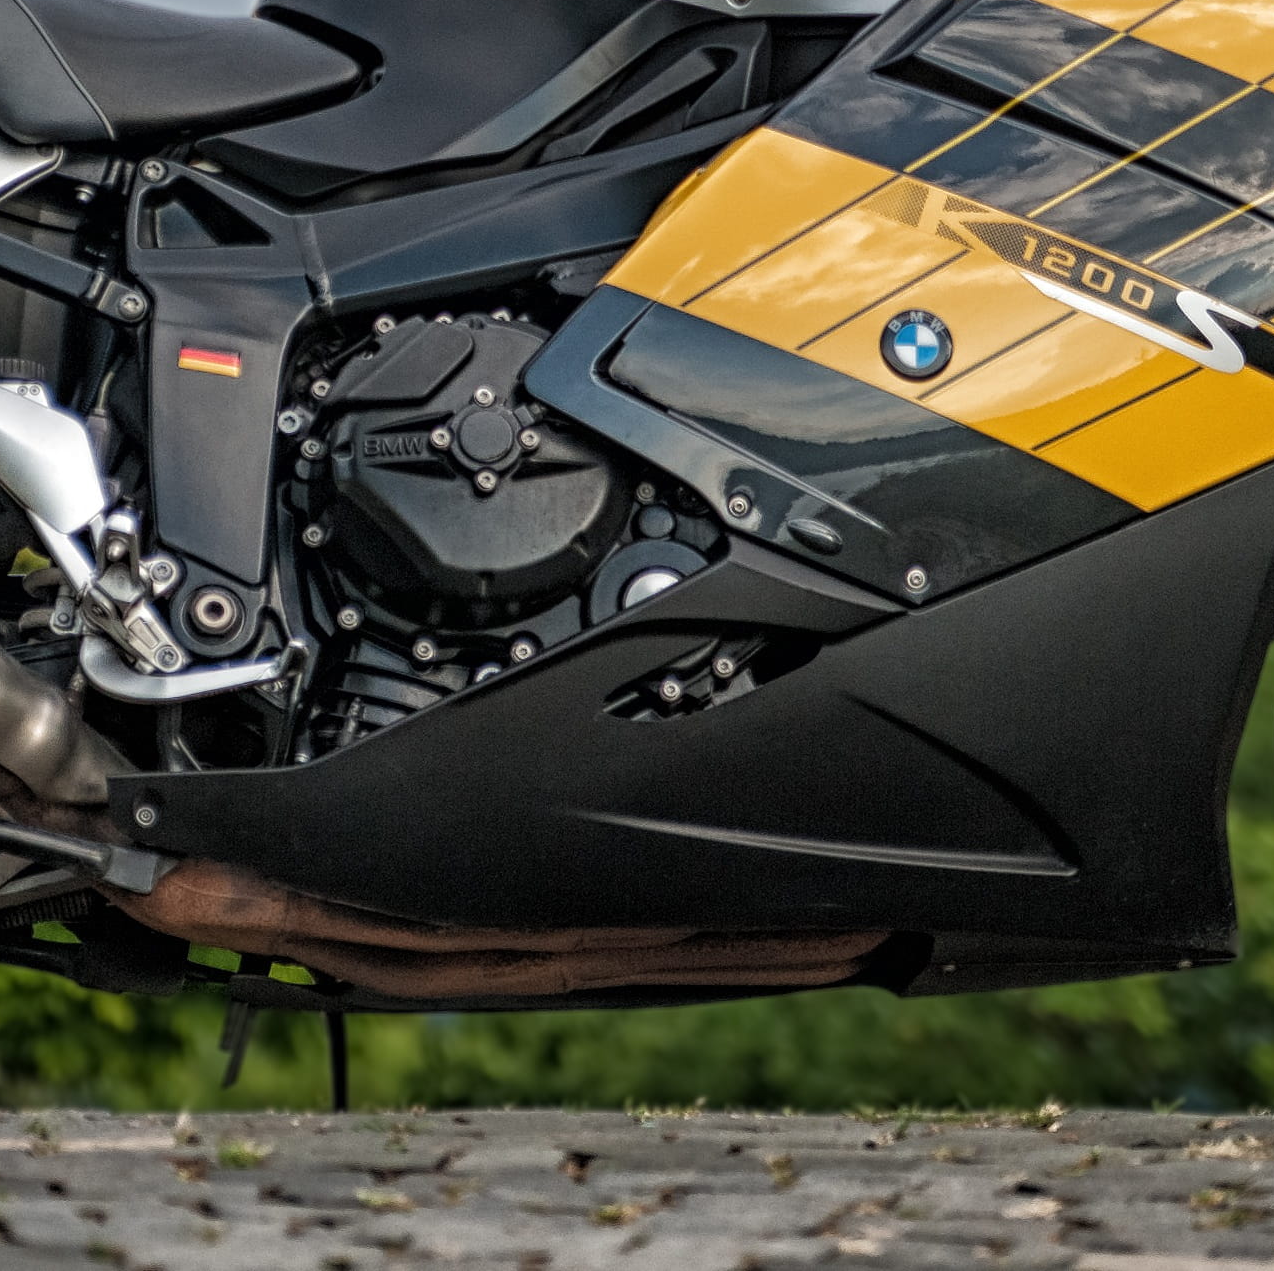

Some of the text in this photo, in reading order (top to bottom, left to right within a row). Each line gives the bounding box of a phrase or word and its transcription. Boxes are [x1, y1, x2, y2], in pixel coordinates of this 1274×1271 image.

[1022, 235, 1155, 311] 1200
[887, 310, 945, 333] BMW
[364, 436, 425, 457] BMW
